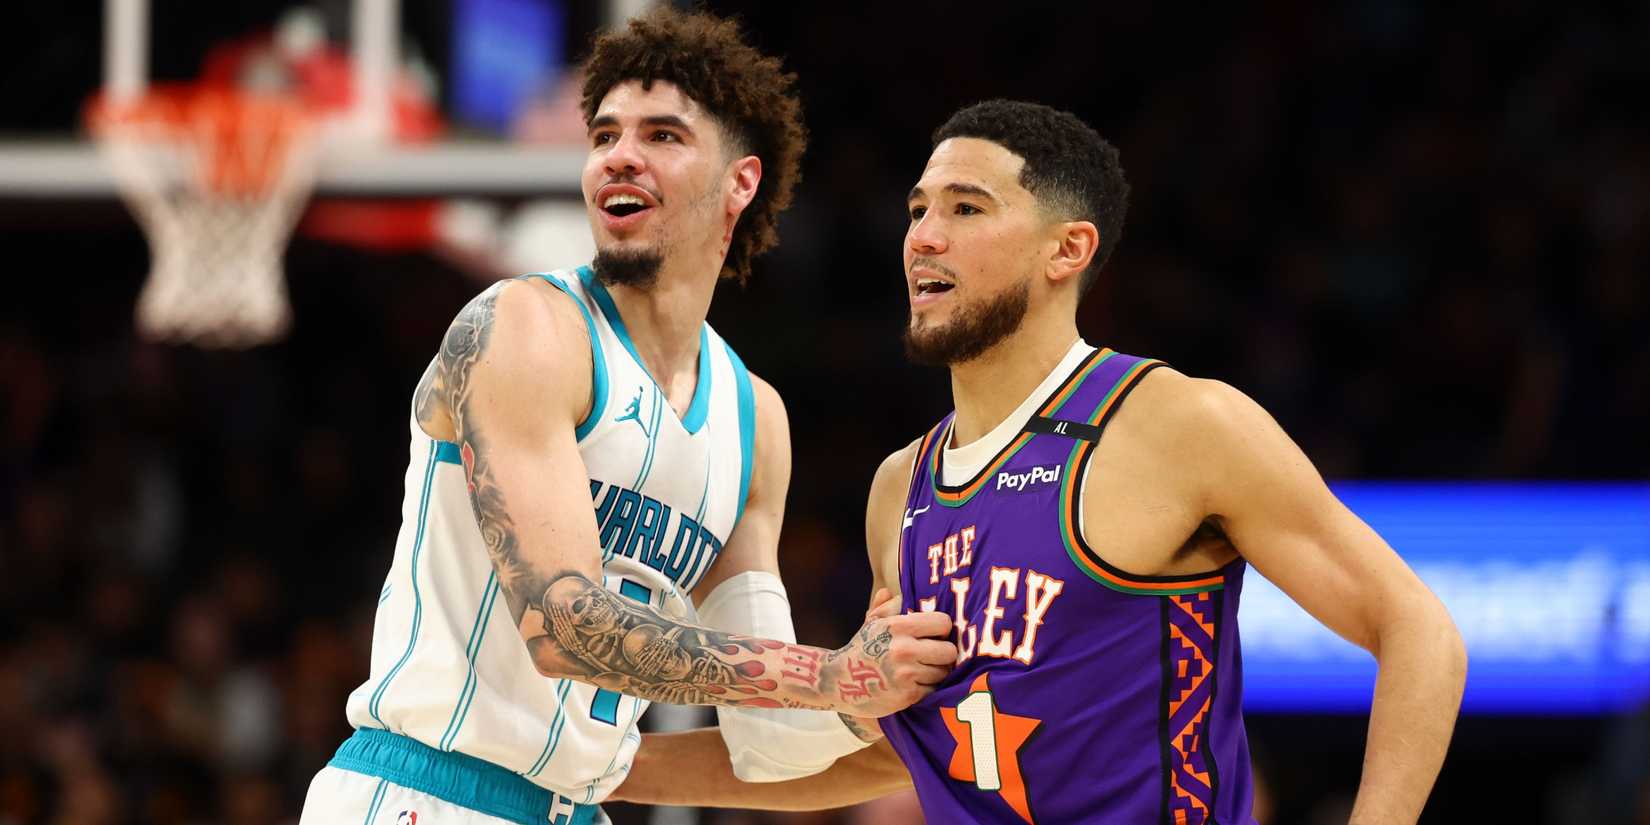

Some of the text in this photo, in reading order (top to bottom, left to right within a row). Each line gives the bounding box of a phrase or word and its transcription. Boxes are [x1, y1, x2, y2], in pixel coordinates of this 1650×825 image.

[1053, 421, 1069, 435] AL
[996, 464, 1061, 491] PayPal
[927, 525, 976, 585] THE
[906, 565, 1065, 666] LEY
[956, 691, 1002, 790] 1
